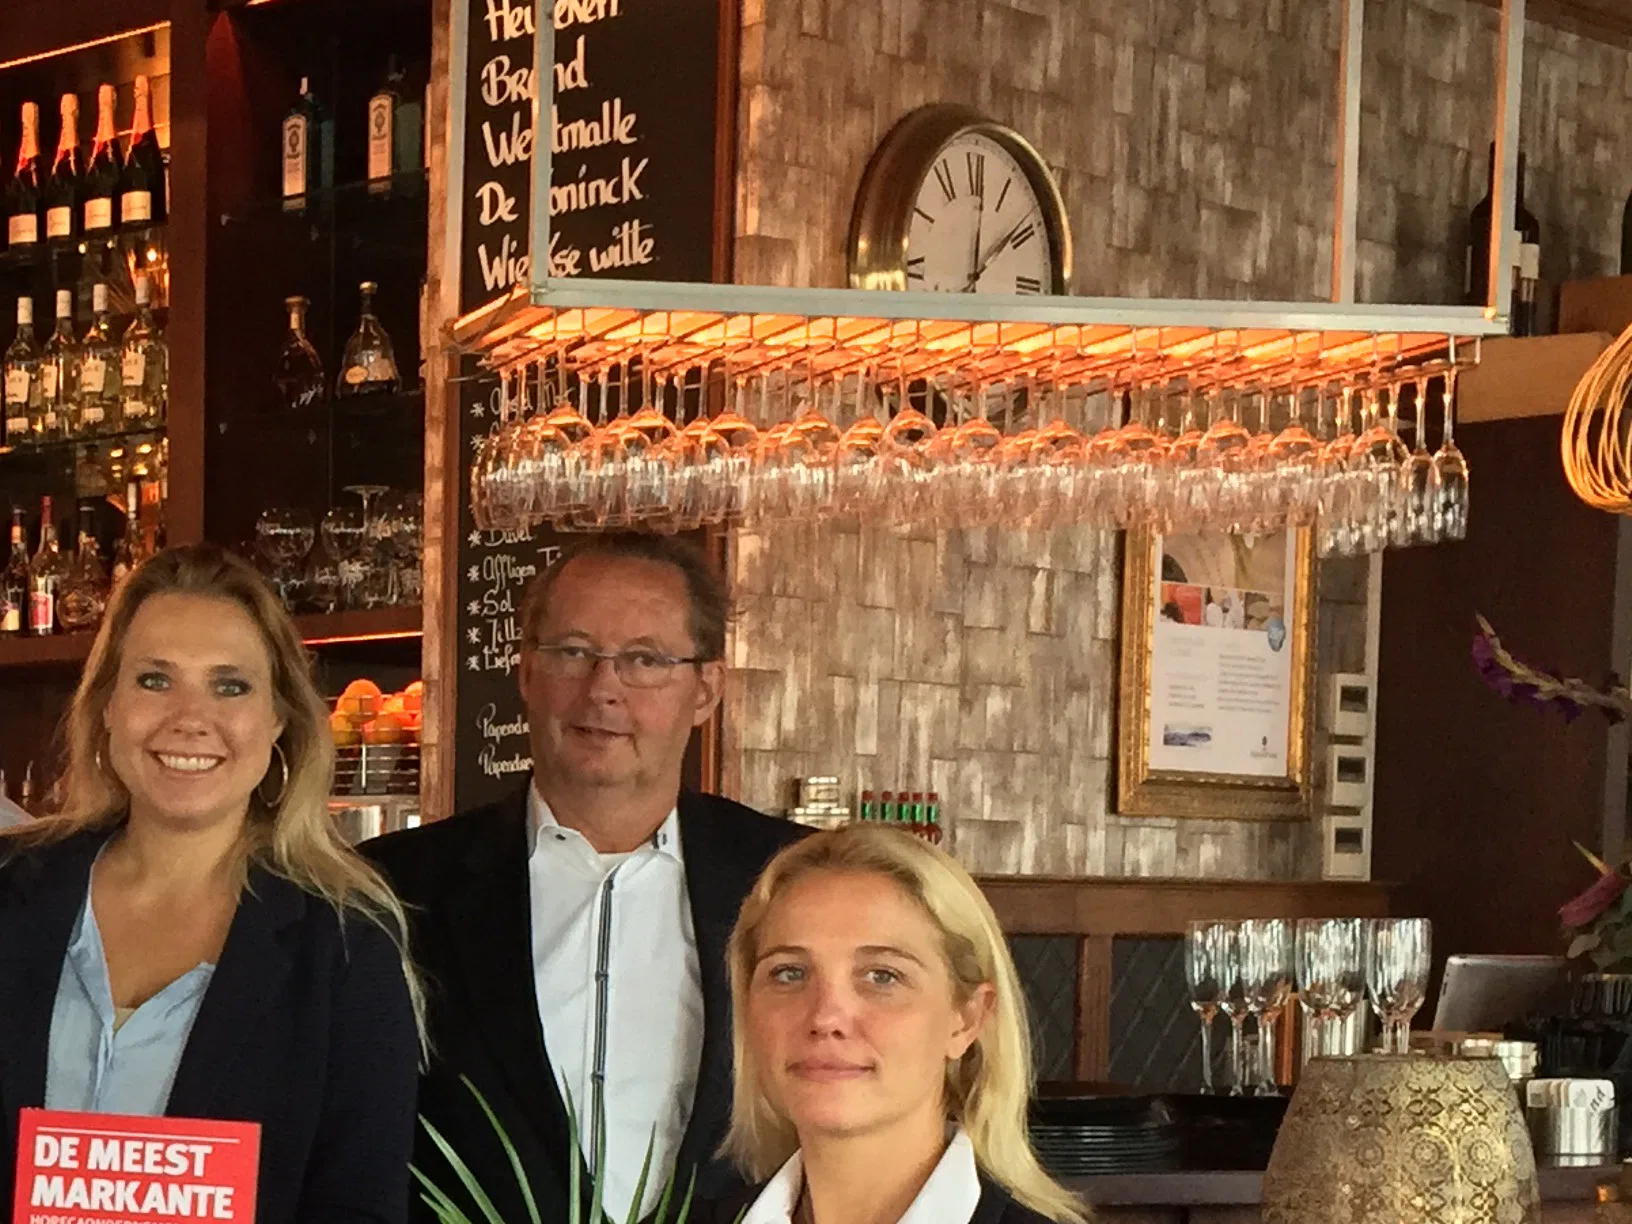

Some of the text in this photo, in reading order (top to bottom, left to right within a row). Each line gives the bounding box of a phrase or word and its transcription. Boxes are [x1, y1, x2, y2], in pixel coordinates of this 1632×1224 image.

[482, 97, 638, 167] Wetmalle
[475, 181, 519, 226] De
[34, 1134, 213, 1178] DE MEEST
[30, 1174, 234, 1220] MARKANTE
